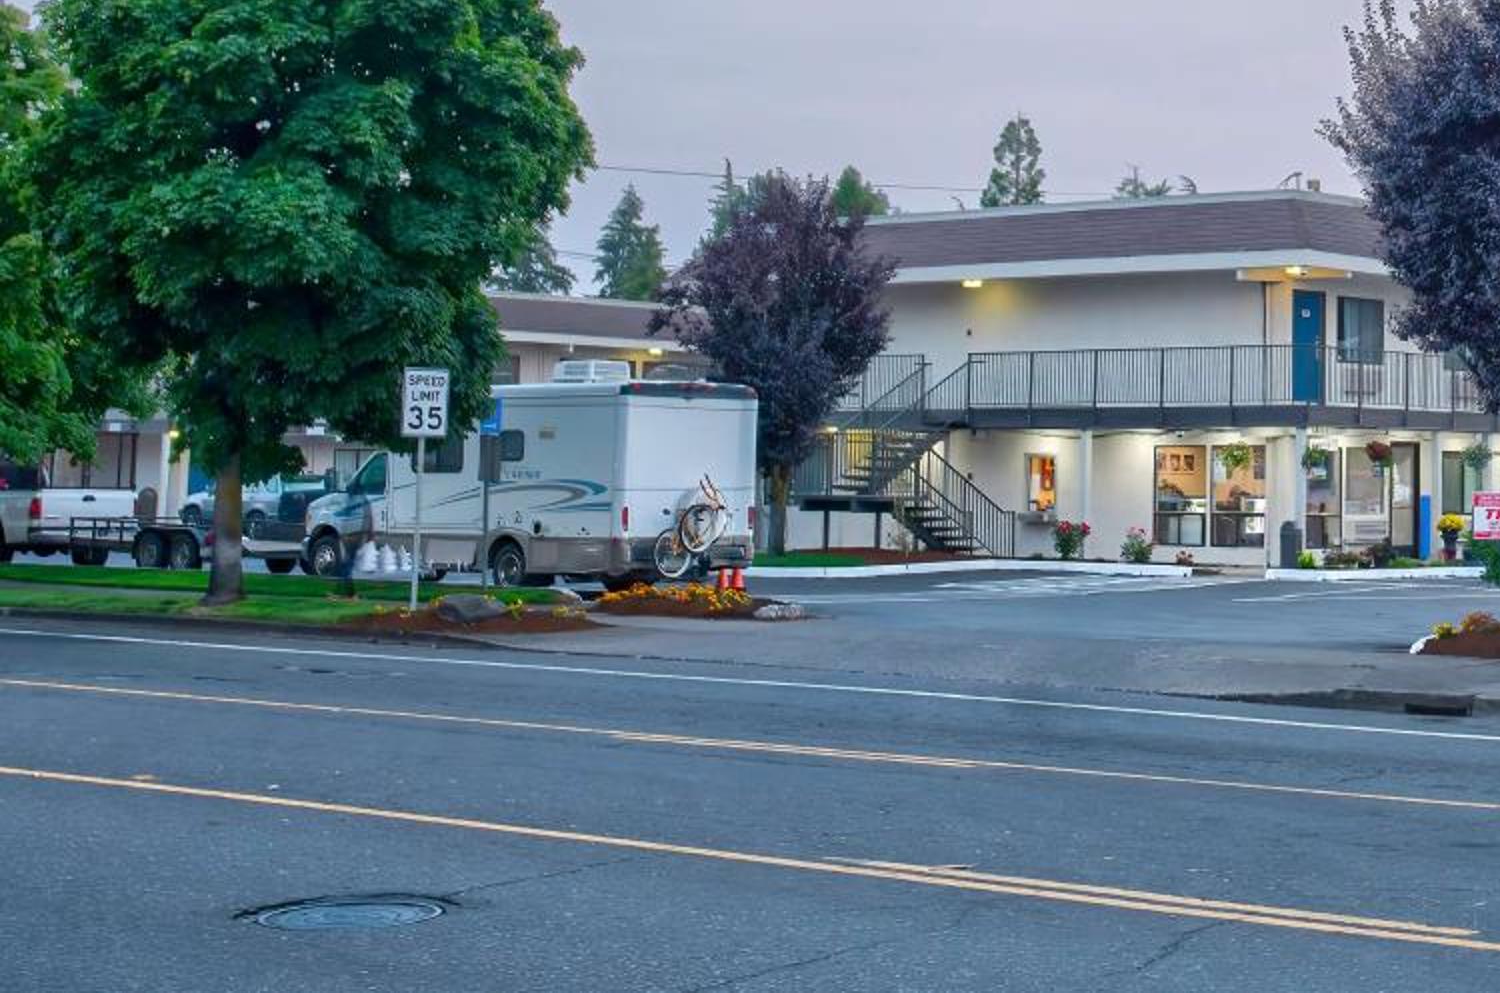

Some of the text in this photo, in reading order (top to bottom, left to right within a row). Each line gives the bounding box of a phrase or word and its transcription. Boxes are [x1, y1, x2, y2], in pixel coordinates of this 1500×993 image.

[408, 374, 446, 387] SPEED
[411, 390, 441, 403] LIMIT
[407, 405, 443, 430] 35
